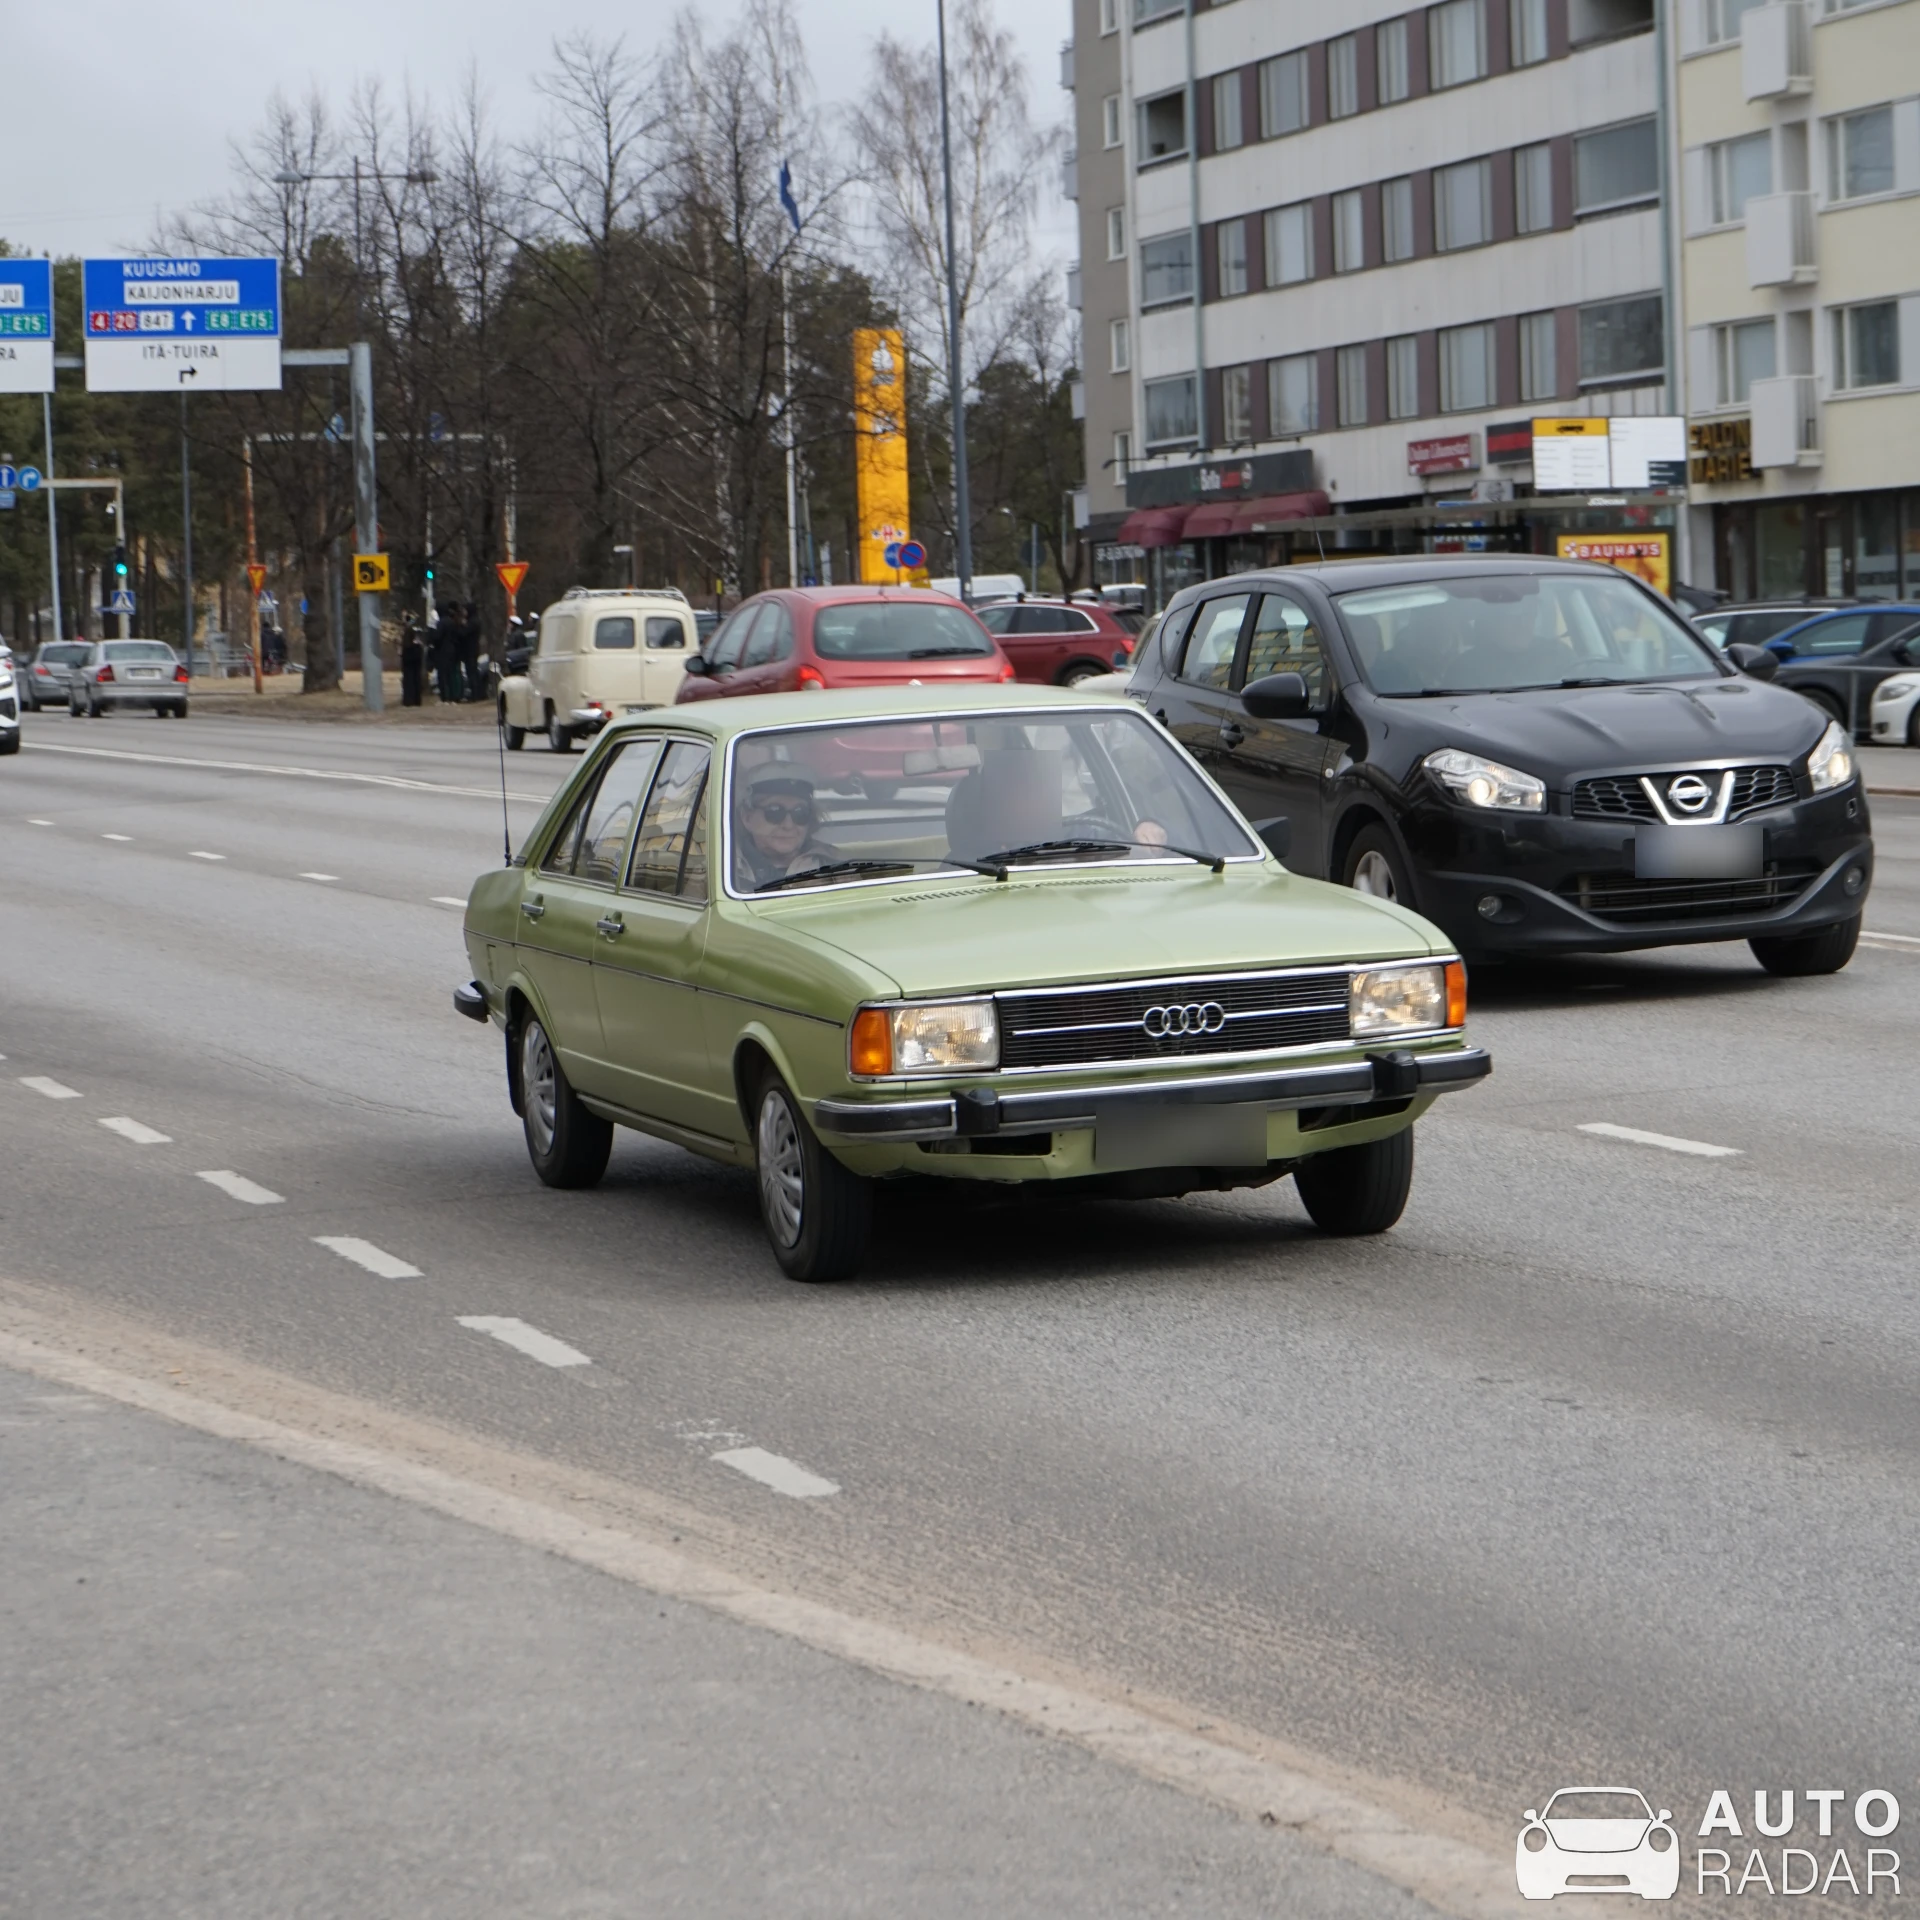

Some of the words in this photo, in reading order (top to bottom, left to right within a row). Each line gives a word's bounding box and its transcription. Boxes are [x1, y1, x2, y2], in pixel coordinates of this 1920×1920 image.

[123, 261, 201, 277] KUUSAMO
[128, 286, 236, 300] KAIJONHARJU
[95, 313, 106, 329] 4
[115, 314, 137, 329] 20
[143, 314, 170, 328] 847
[209, 312, 230, 328] E8
[240, 311, 268, 328] E75
[142, 343, 219, 360] ITÄ-TUIRA
[1580, 543, 1660, 559] BAUHAUS
